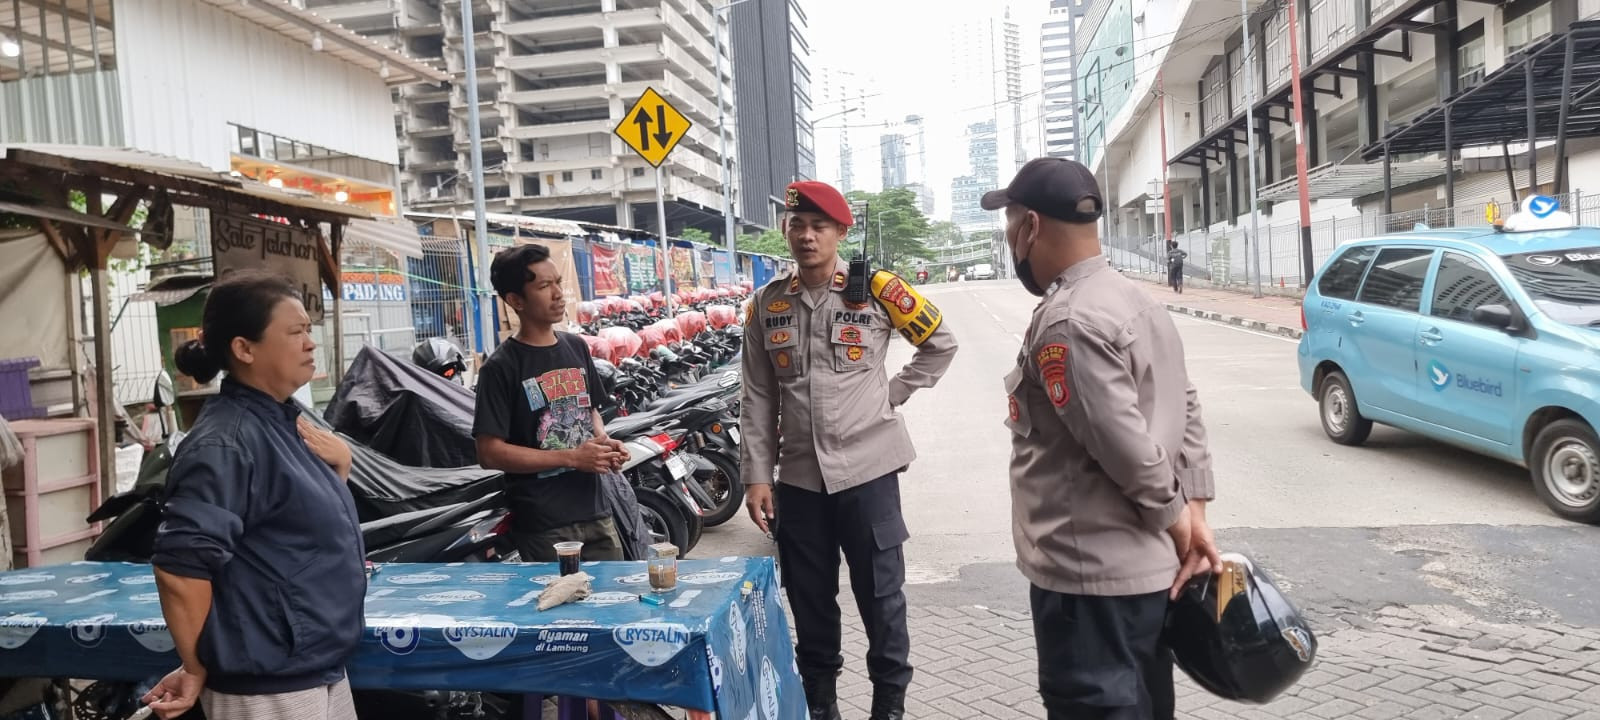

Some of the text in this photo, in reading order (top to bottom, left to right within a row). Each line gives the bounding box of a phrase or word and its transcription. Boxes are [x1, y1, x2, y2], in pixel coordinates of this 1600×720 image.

[765, 315, 792, 328] RUDY
[835, 311, 871, 325] POLRI
[1456, 373, 1502, 397] Bluebird
[538, 629, 589, 643] Nyaman
[615, 627, 689, 646] CRYSTALIN
[535, 644, 589, 653] di Lambung
